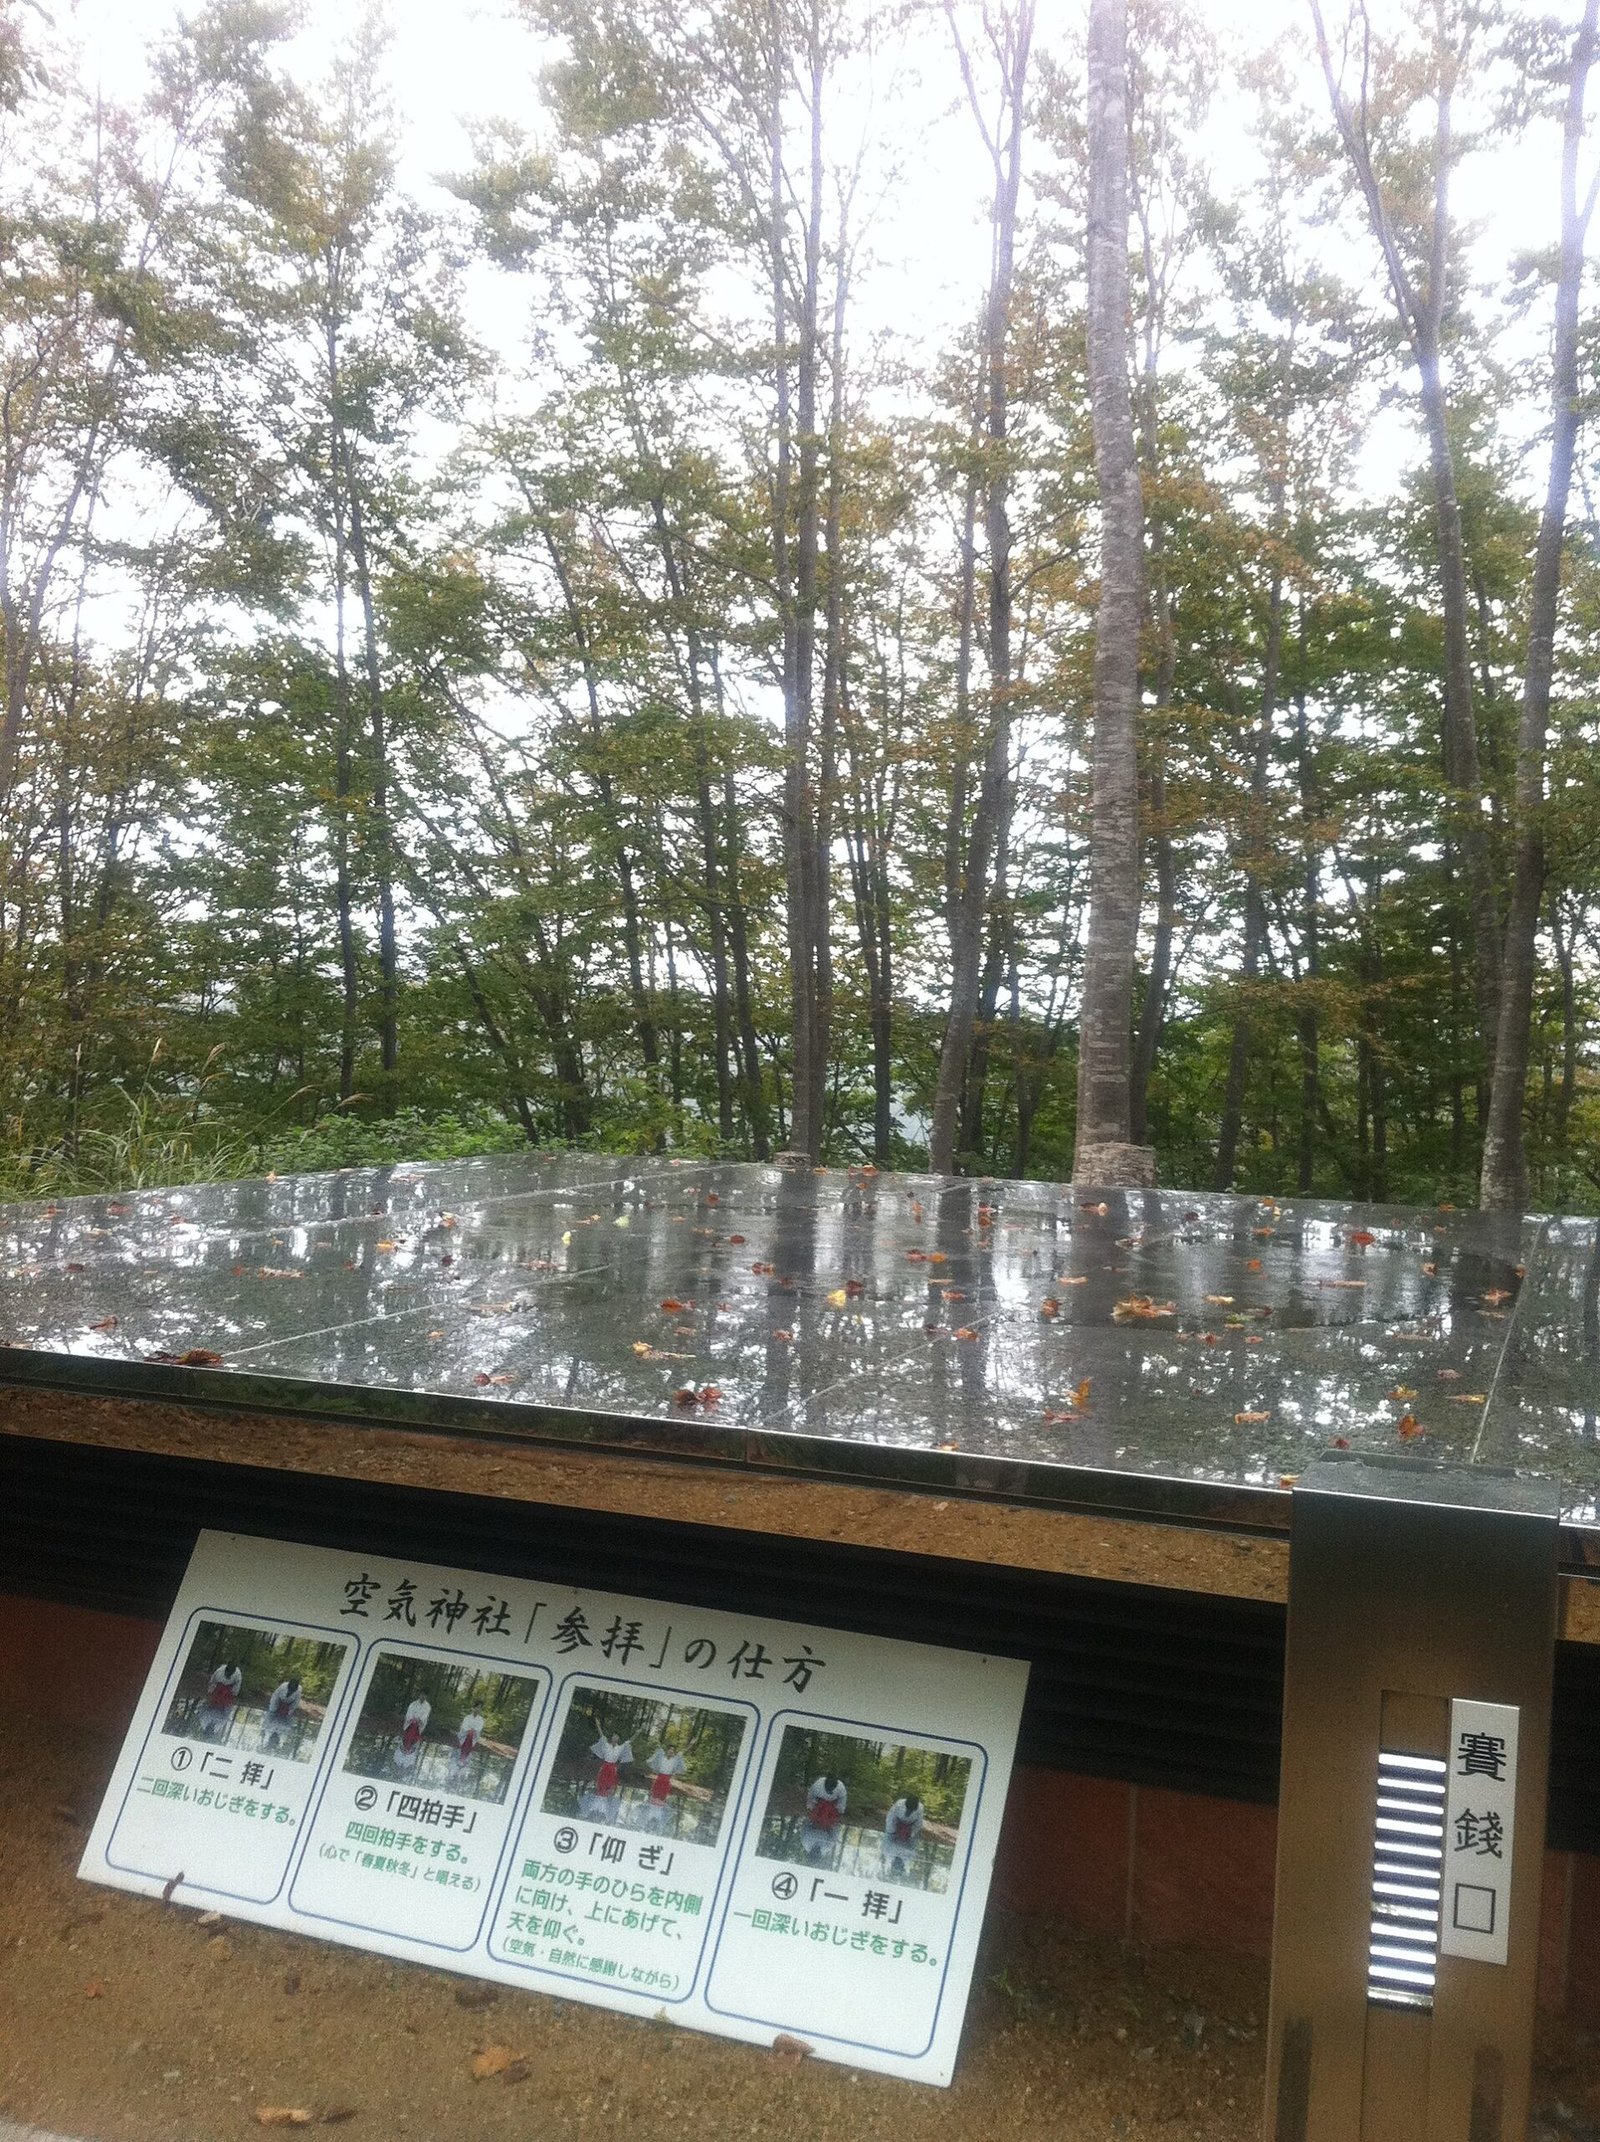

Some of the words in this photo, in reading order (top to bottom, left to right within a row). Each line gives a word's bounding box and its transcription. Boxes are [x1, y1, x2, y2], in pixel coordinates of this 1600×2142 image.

[340, 1573, 826, 1694] 空気神社「参拝」の仕方
[136, 1776, 296, 1826] 二回深いおじぎをする。
[345, 1821, 468, 1864] 四回拍手をする。
[515, 1885, 682, 1940] に向け、上にあげて、
[521, 1859, 704, 1915] 両方の手のひらを内側
[506, 1911, 585, 1946] 天を仰ぐ。
[733, 1908, 937, 1966] 一回深いおじぎをする。
